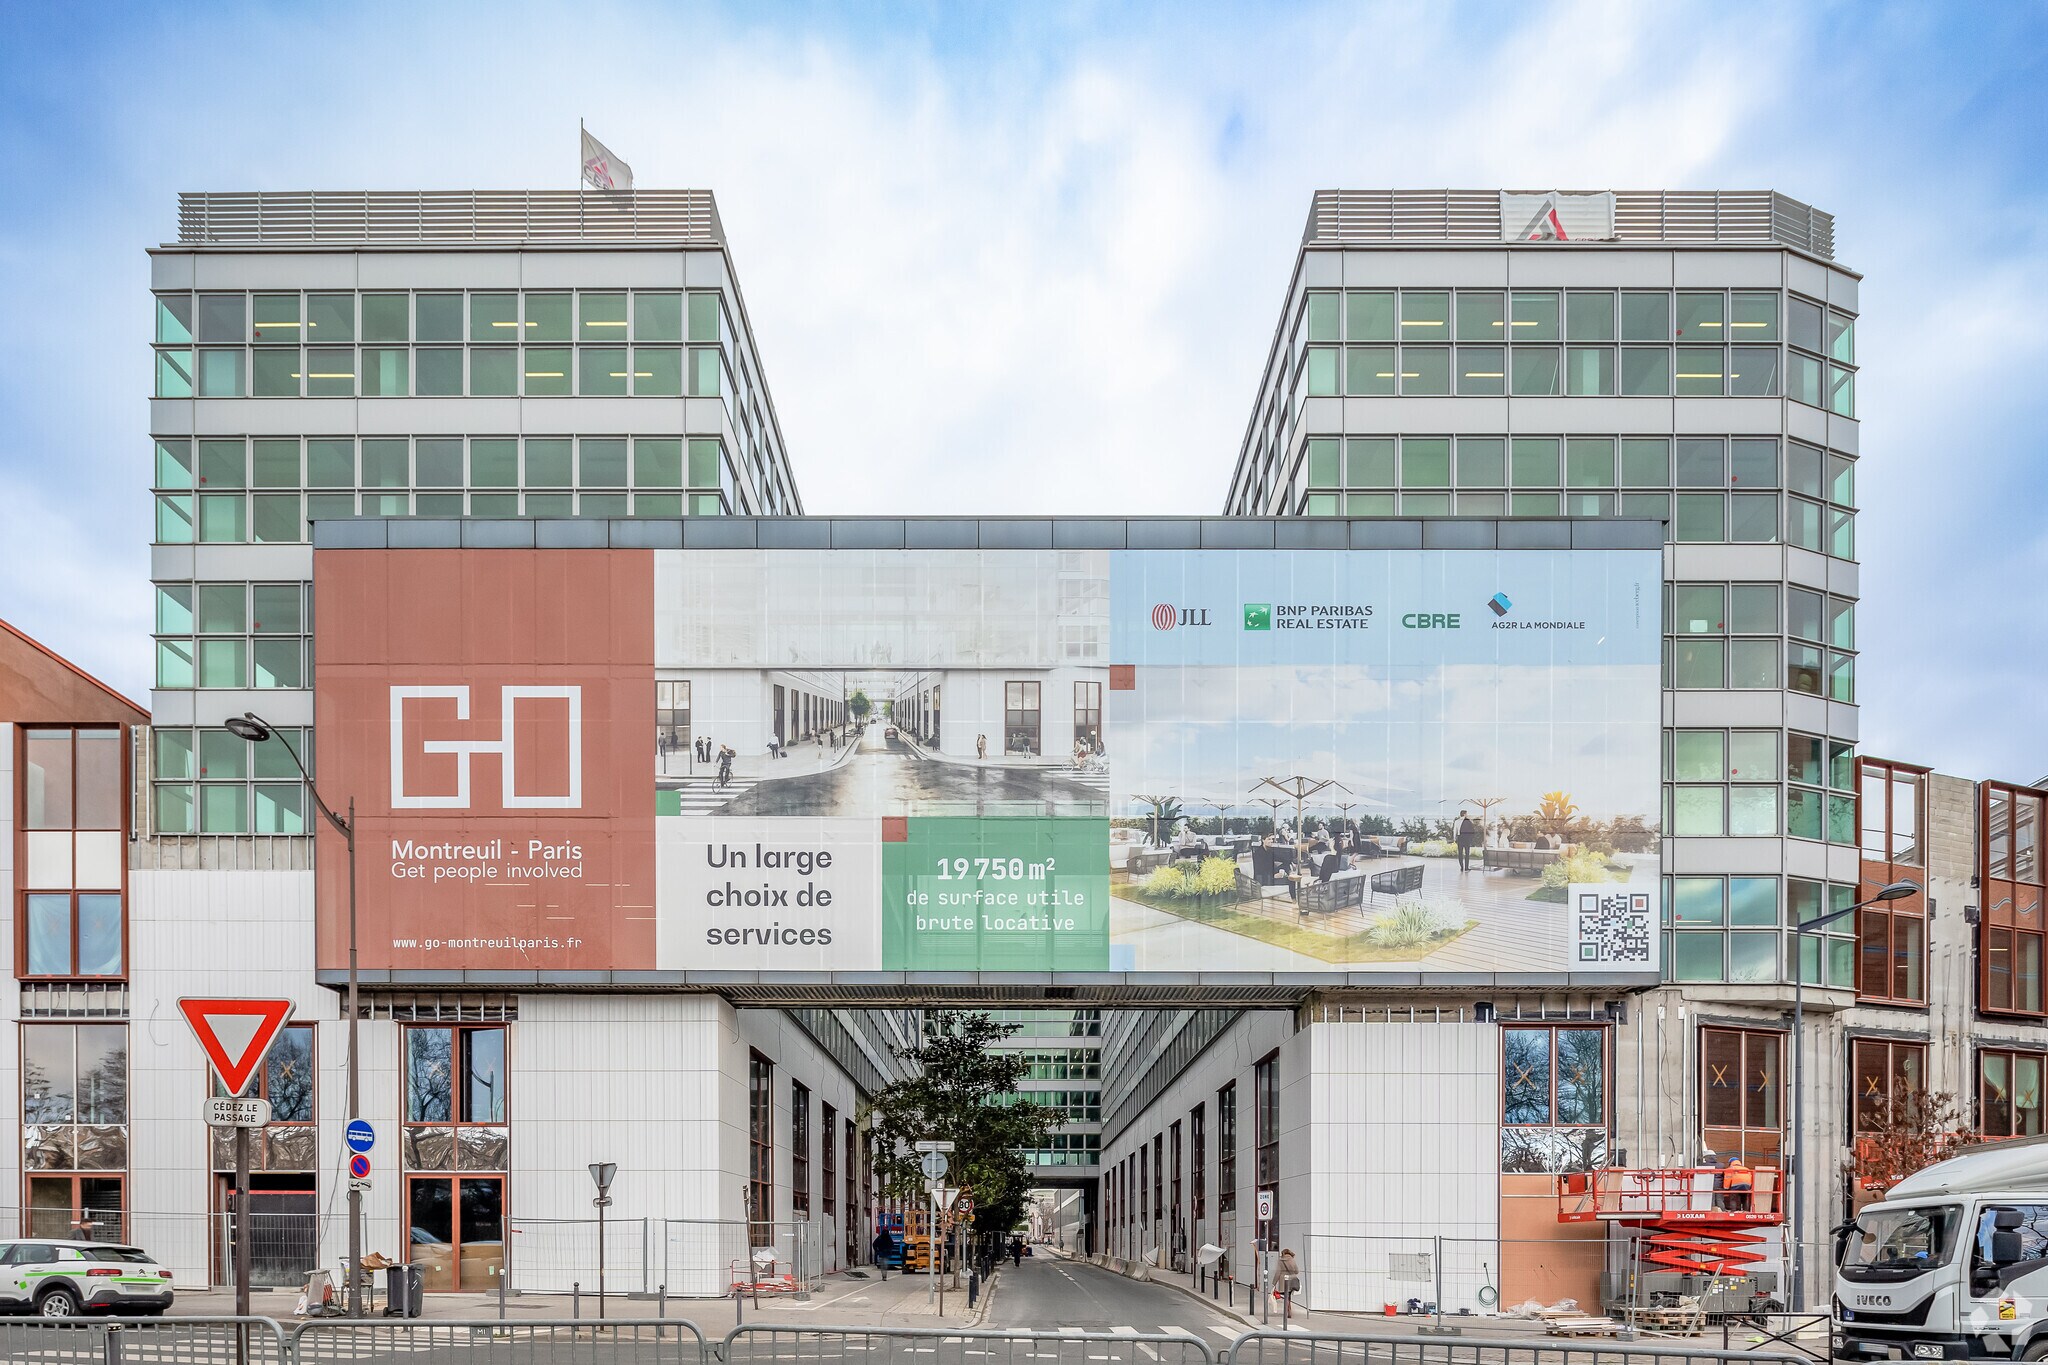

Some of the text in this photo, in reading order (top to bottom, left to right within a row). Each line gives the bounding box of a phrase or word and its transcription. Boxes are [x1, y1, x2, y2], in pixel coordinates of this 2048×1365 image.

[1178, 608, 1212, 626] JLL
[1277, 606, 1373, 616] BNP PARIBAS
[1277, 619, 1368, 629] REAL ESTATE
[1402, 613, 1461, 629] CBRE
[1491, 621, 1586, 630] AG2R LA MONDIALE
[391, 839, 502, 860] Montreuil
[528, 839, 583, 860] Paris
[707, 843, 832, 876] Un large
[391, 861, 582, 884] Get people involved
[706, 881, 832, 907] choix de
[906, 890, 1085, 906] de surface utile
[916, 915, 1075, 931] brute locative
[706, 921, 832, 945] services
[392, 936, 583, 951] www.go-montreuilparis.fr
[213, 1101, 258, 1112] CÉDEZ LE
[214, 1113, 256, 1122] PASSAGE
[1857, 1295, 1892, 1306] IVECO
